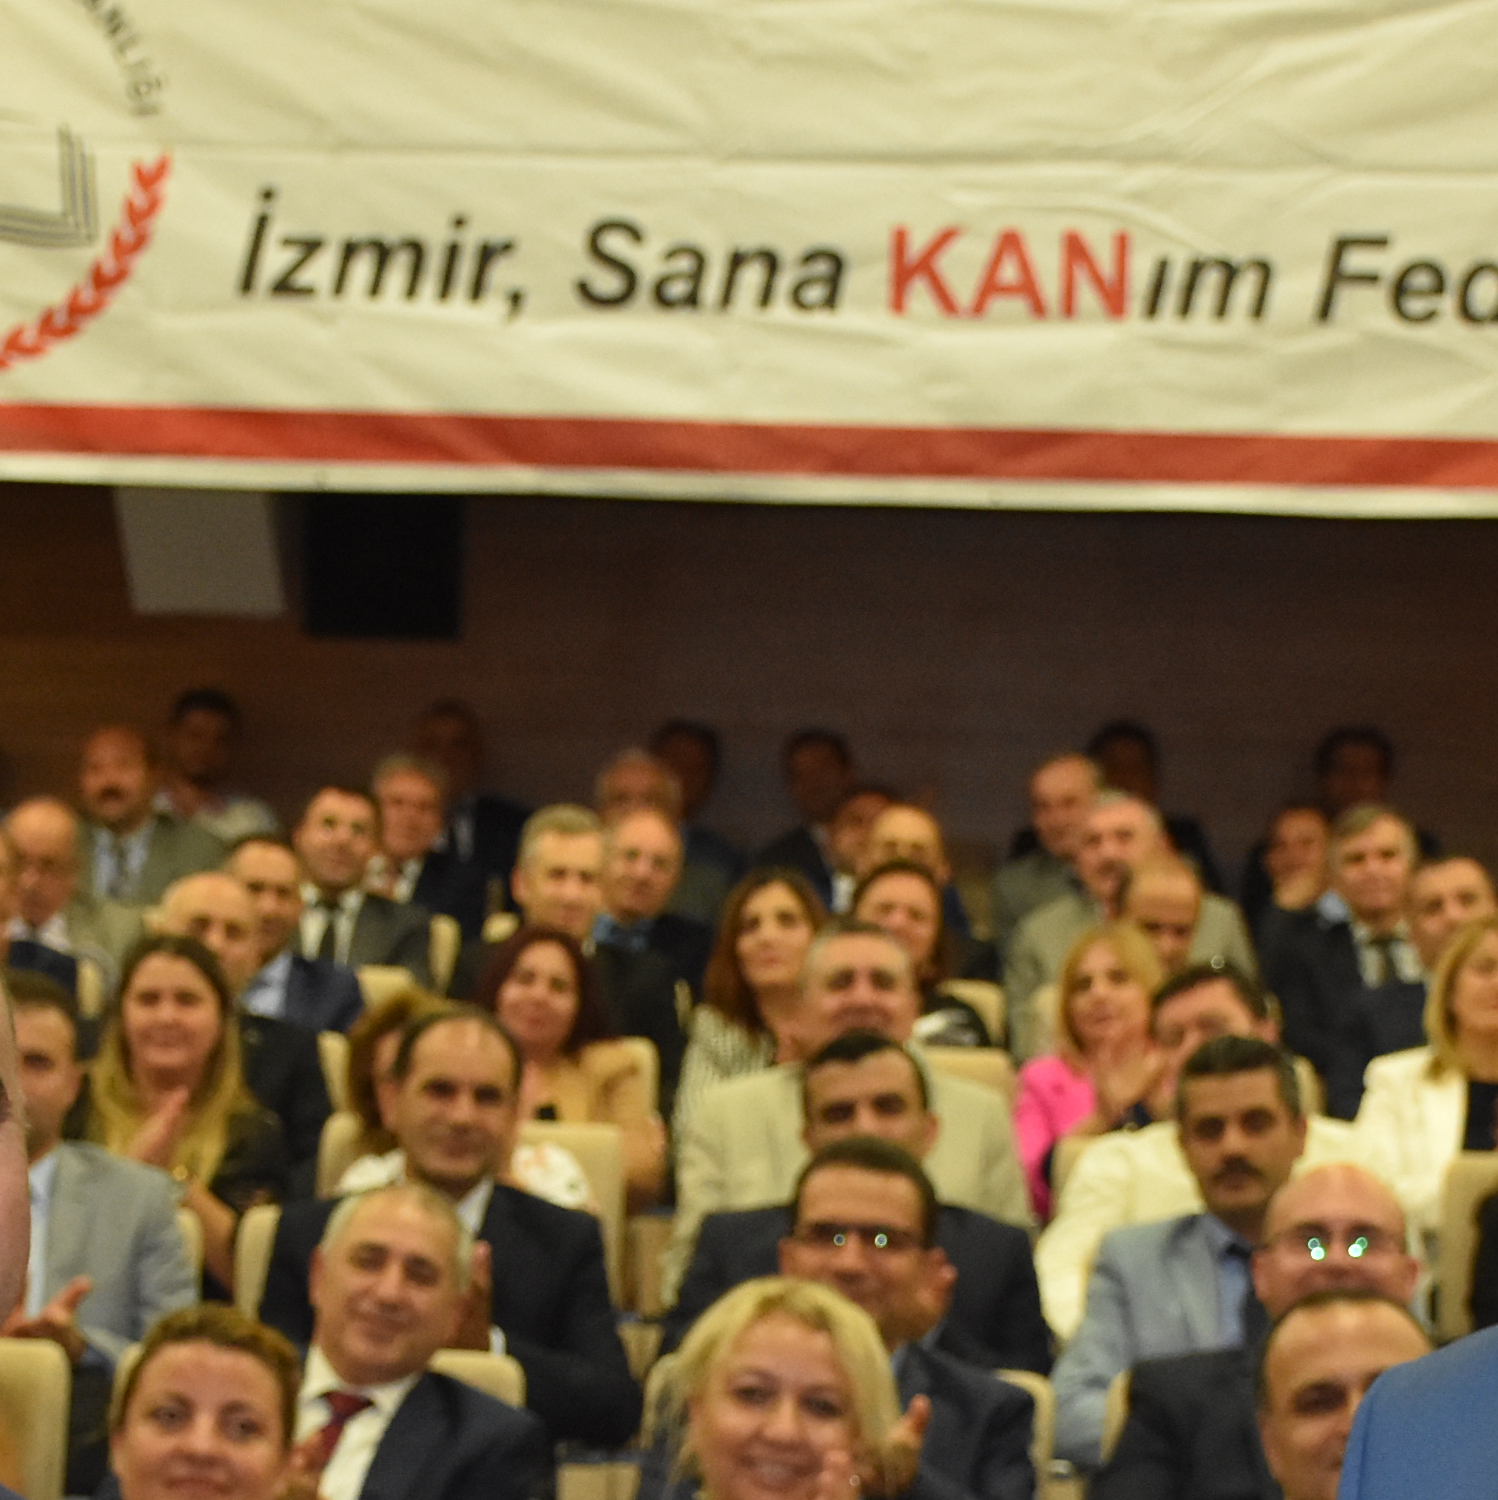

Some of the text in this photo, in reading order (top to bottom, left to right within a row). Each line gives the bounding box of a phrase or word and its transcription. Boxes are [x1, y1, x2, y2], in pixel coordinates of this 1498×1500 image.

[237, 187, 526, 318] İzmir,
[574, 216, 847, 313] Sana
[887, 225, 1275, 321] KANım
